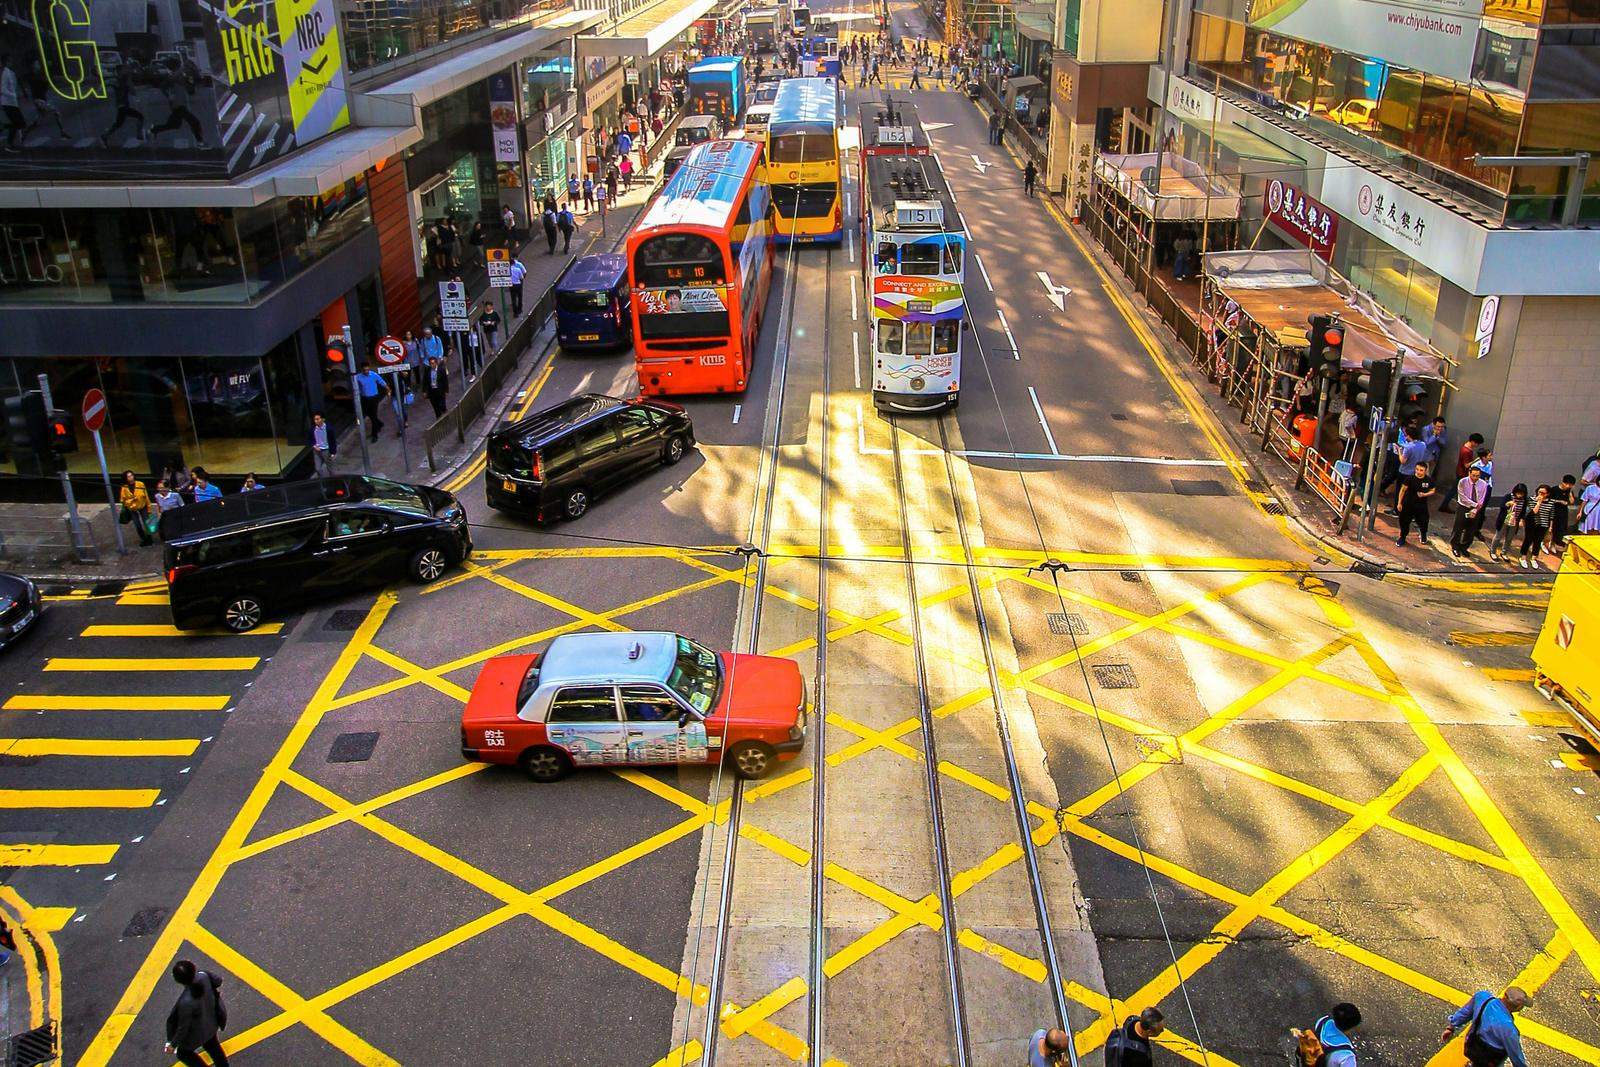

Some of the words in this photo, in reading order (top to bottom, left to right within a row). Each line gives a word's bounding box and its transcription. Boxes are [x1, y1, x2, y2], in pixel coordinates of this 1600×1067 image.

[1387, 12, 1462, 35] www.chiyubank.com
[295, 11, 325, 51] NRC
[221, 21, 275, 86] HKG
[887, 132, 905, 141] 152
[909, 210, 932, 222] 151
[1374, 193, 1426, 239] 集友銀行
[647, 302, 667, 313] 英文
[700, 355, 726, 366] KMB
[239, 373, 250, 383] FLY
[485, 729, 504, 739] 的士
